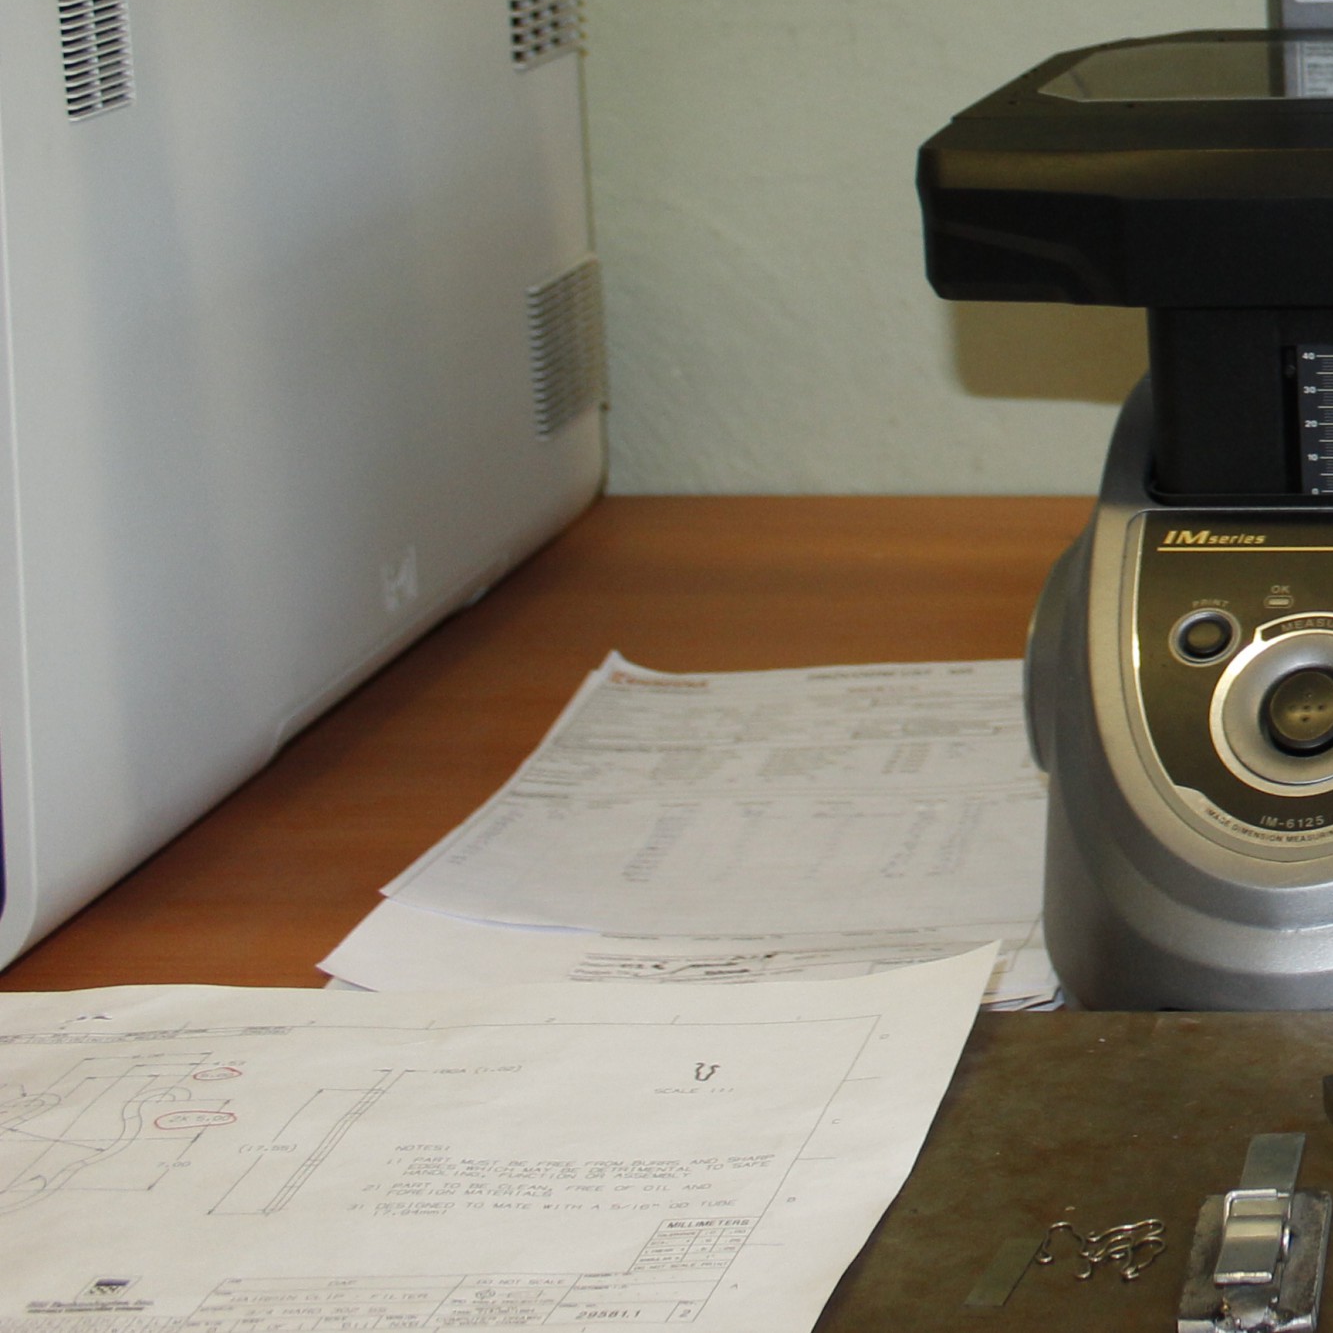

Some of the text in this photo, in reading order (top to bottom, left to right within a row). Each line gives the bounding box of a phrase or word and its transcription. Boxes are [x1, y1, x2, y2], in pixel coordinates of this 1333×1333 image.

[1302, 352, 1316, 360] 40
[1303, 386, 1317, 394] 30
[1304, 420, 1318, 428] 20
[1307, 453, 1319, 462] 10
[1311, 487, 1320, 495] 0
[1270, 585, 1290, 595] OK
[1192, 598, 1230, 609] PRINT
[1205, 807, 1230, 827] IMAGE
[1231, 823, 1283, 843] DIMENSION
[1259, 815, 1326, 829] IM-6125
[667, 1218, 750, 1229] MILLIMETERS
